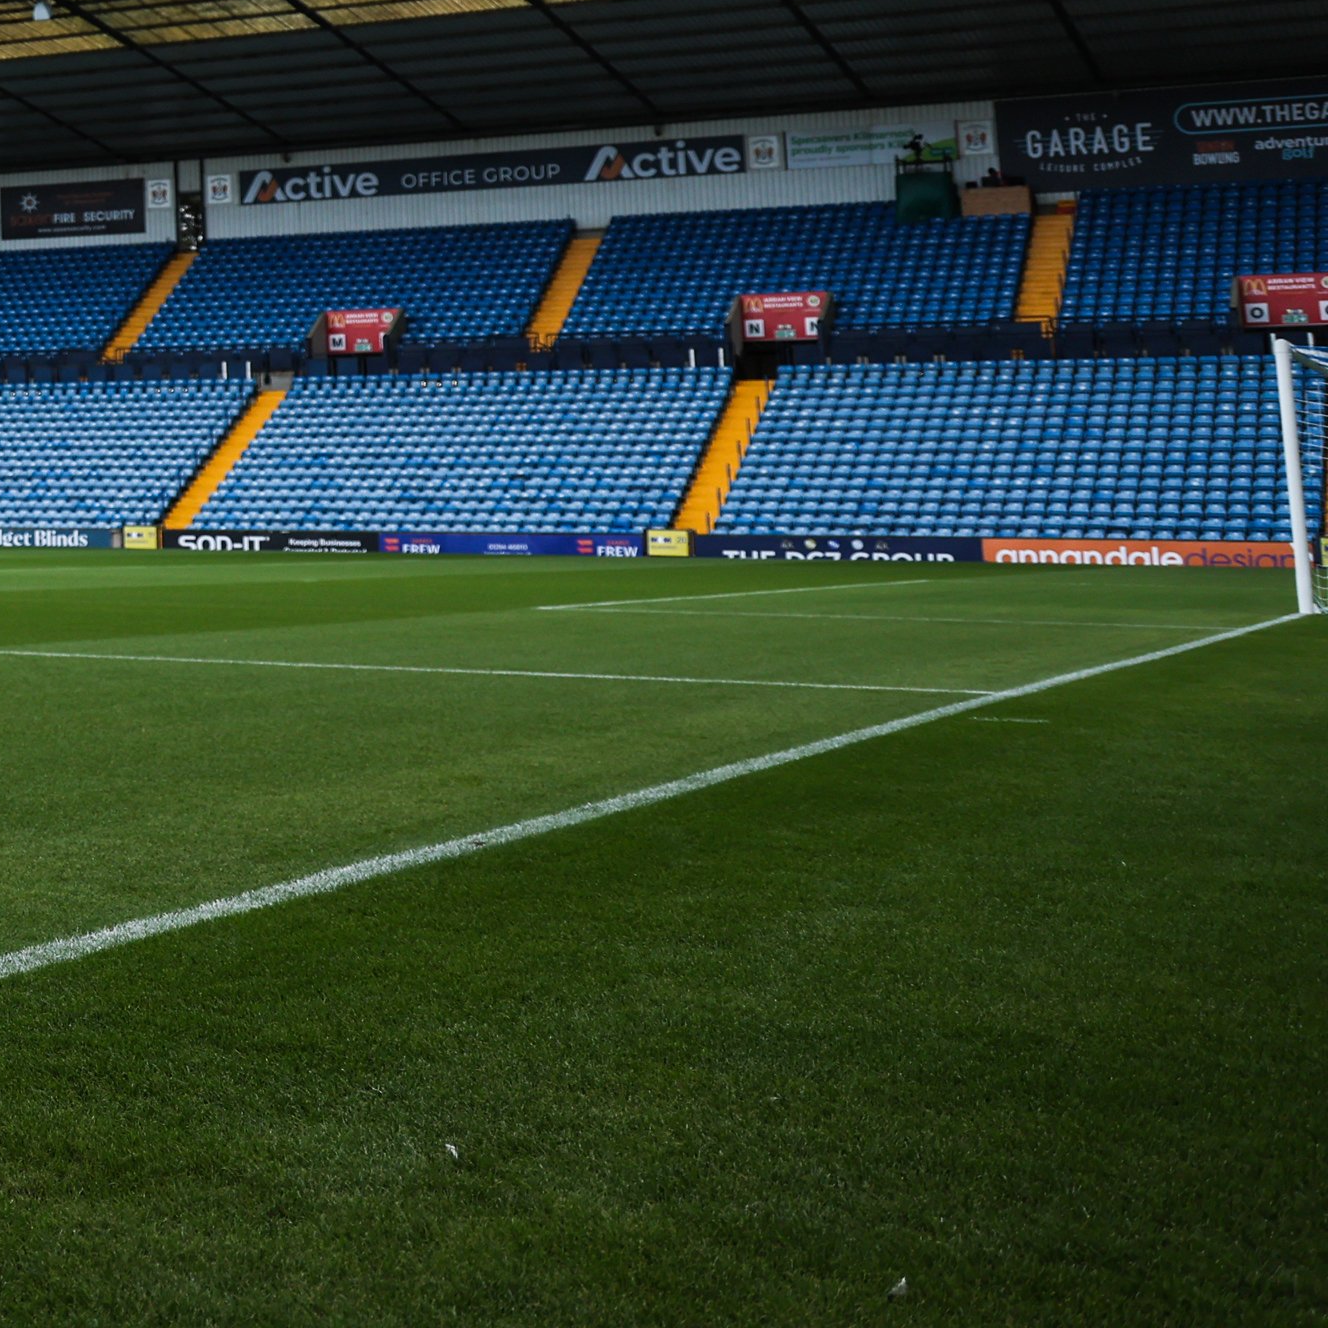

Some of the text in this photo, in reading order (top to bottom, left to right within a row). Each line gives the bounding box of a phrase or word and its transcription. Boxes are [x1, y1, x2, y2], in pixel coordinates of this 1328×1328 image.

[1075, 112, 1096, 122] THE
[1025, 122, 1155, 159] GARAGE
[1039, 162, 1085, 173] LEISURE
[1093, 156, 1143, 172] COMPLEX
[242, 140, 742, 203] Active OFFICE GROUP Active
[53, 212, 76, 224] FIRE
[83, 208, 135, 223] SECURITY
[749, 323, 760, 334] N
[34, 529, 88, 547] Blinds
[288, 538, 361, 548] Keeping Businesses
[402, 543, 441, 554] FREW
[596, 545, 638, 557] FREW
